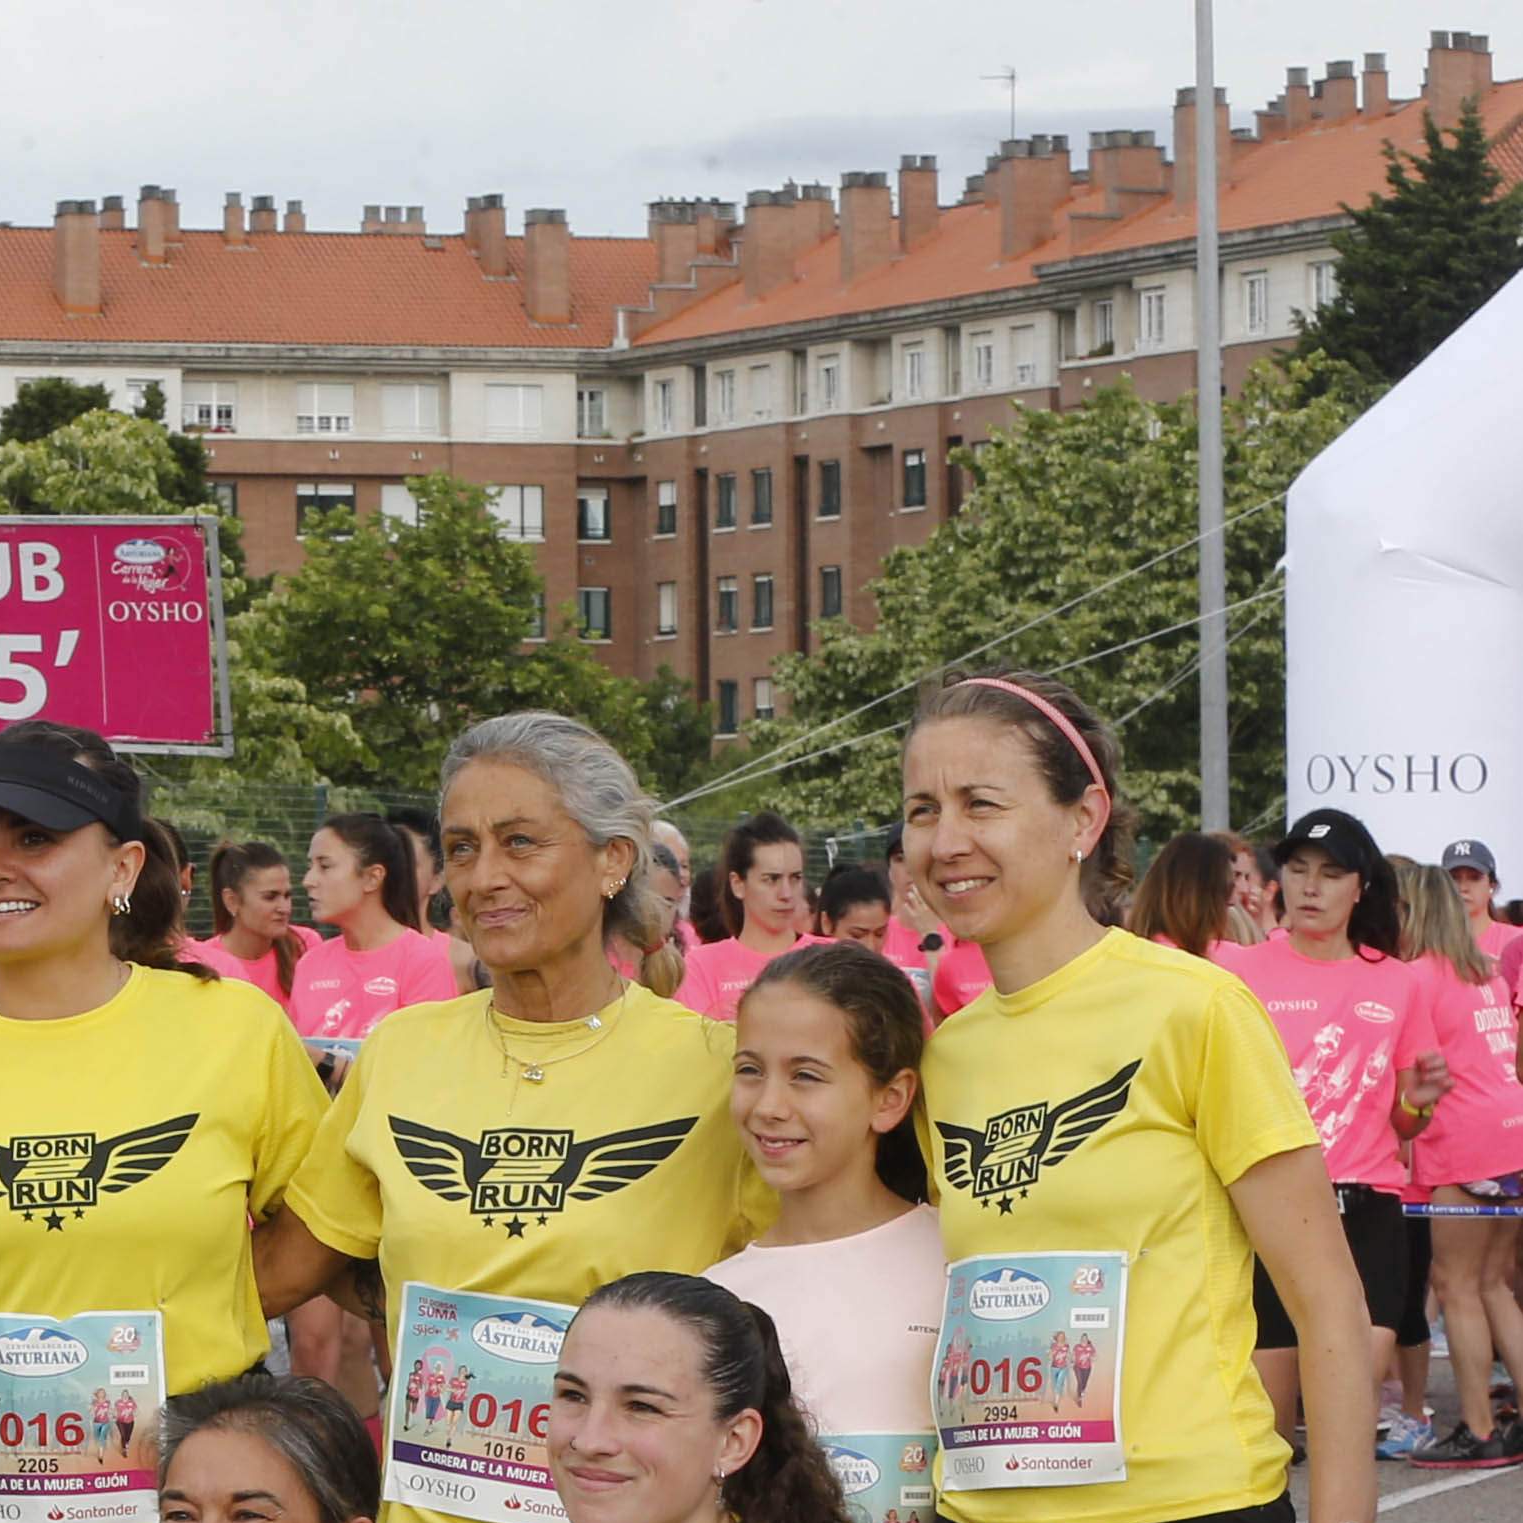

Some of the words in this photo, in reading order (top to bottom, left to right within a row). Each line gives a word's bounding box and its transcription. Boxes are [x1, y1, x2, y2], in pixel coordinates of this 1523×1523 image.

[108, 600, 203, 623] OYSHO
[1306, 753, 1488, 794] OYSHO
[1267, 999, 1319, 1013] OYSHO
[989, 1110, 1043, 1144] BORN
[15, 1139, 90, 1159] BORN
[485, 1135, 566, 1158] BORN
[978, 1158, 1035, 1192] RUN
[15, 1181, 91, 1204] RUN
[478, 1184, 559, 1209] RUN
[1075, 1268, 1099, 1285] 20
[971, 1291, 1044, 1310] ASTURIANA
[418, 1305, 458, 1321] SUMA
[113, 1327, 136, 1343] 20
[970, 1357, 1043, 1396] 016
[468, 1393, 552, 1438] 016
[984, 1406, 1018, 1422] 2994
[0, 1412, 85, 1447] 016
[978, 1428, 989, 1440] DE
[990, 1427, 1002, 1439] LA
[1004, 1426, 1039, 1439] MUJER
[1048, 1423, 1081, 1439] GIJÓN
[484, 1441, 526, 1462] 1016
[904, 1446, 924, 1463] 20
[17, 1458, 59, 1473] 2205
[421, 1450, 467, 1471] CARRERA
[470, 1460, 486, 1474] DE
[488, 1463, 504, 1477] LA
[507, 1467, 547, 1484] MUJER
[1021, 1456, 1093, 1470] Santander
[10, 1479, 23, 1491] DE
[26, 1479, 40, 1491] LA
[44, 1478, 84, 1491] MUJER
[94, 1475, 128, 1489] GIJÓN
[410, 1474, 476, 1502] OYSHO
[66, 1504, 138, 1520] Santander
